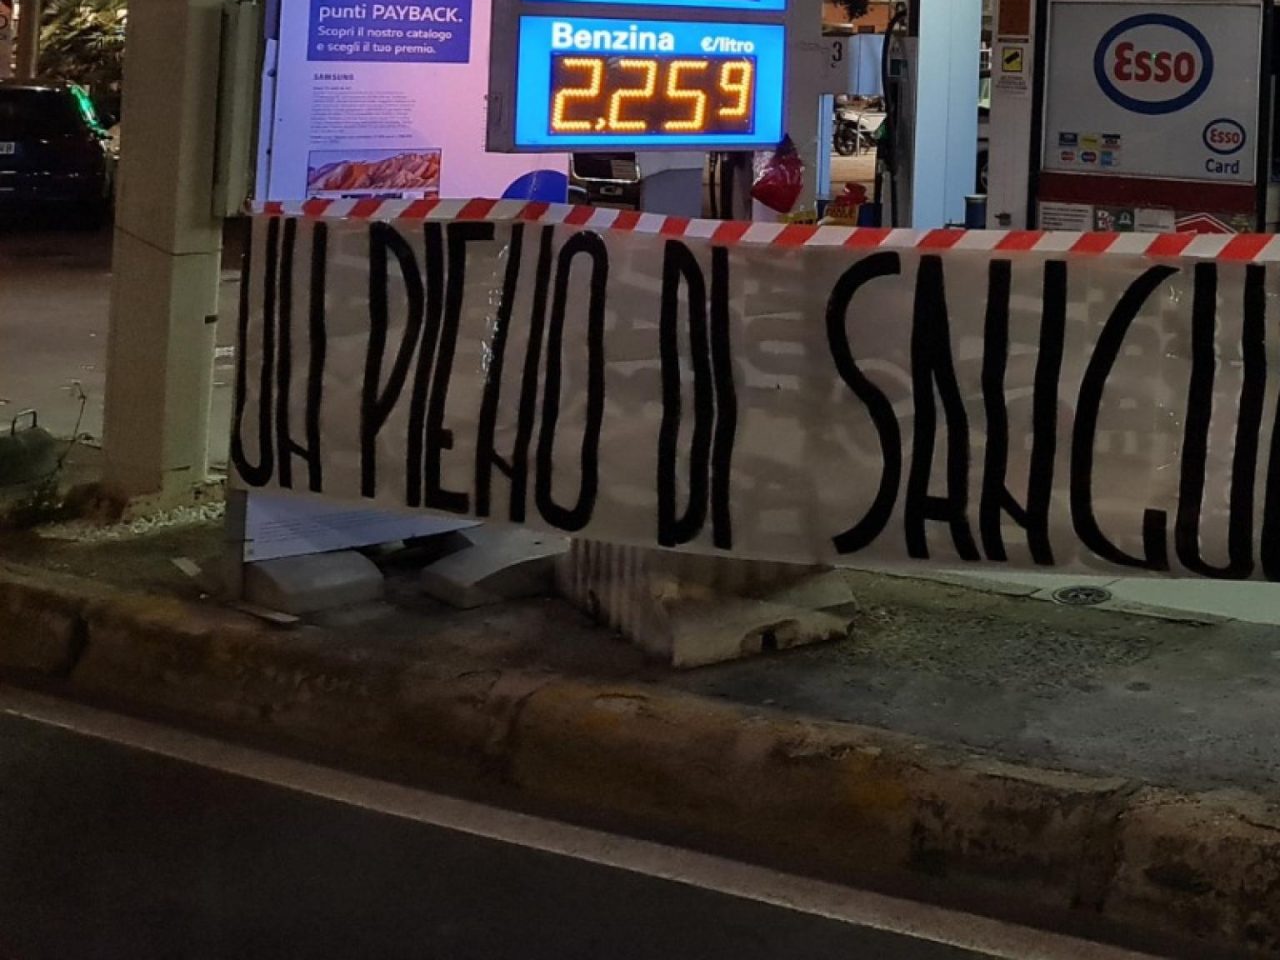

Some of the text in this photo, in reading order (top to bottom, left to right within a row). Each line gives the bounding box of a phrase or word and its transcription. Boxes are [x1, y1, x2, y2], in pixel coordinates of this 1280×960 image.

[319, 5, 463, 23] punti PAYBACK.
[318, 26, 452, 41] Scopri il nostro catalogo
[552, 23, 755, 54] Benzina €/litro
[317, 42, 436, 55] e scegli il tuo premio.
[832, 41, 842, 61] 3
[1113, 42, 1195, 84] Esso
[551, 58, 752, 130] 2,259
[1210, 128, 1240, 144] Esso
[1205, 159, 1240, 174] Card
[232, 216, 326, 493] UN
[362, 220, 609, 532] PIENO
[658, 239, 738, 550] DI
